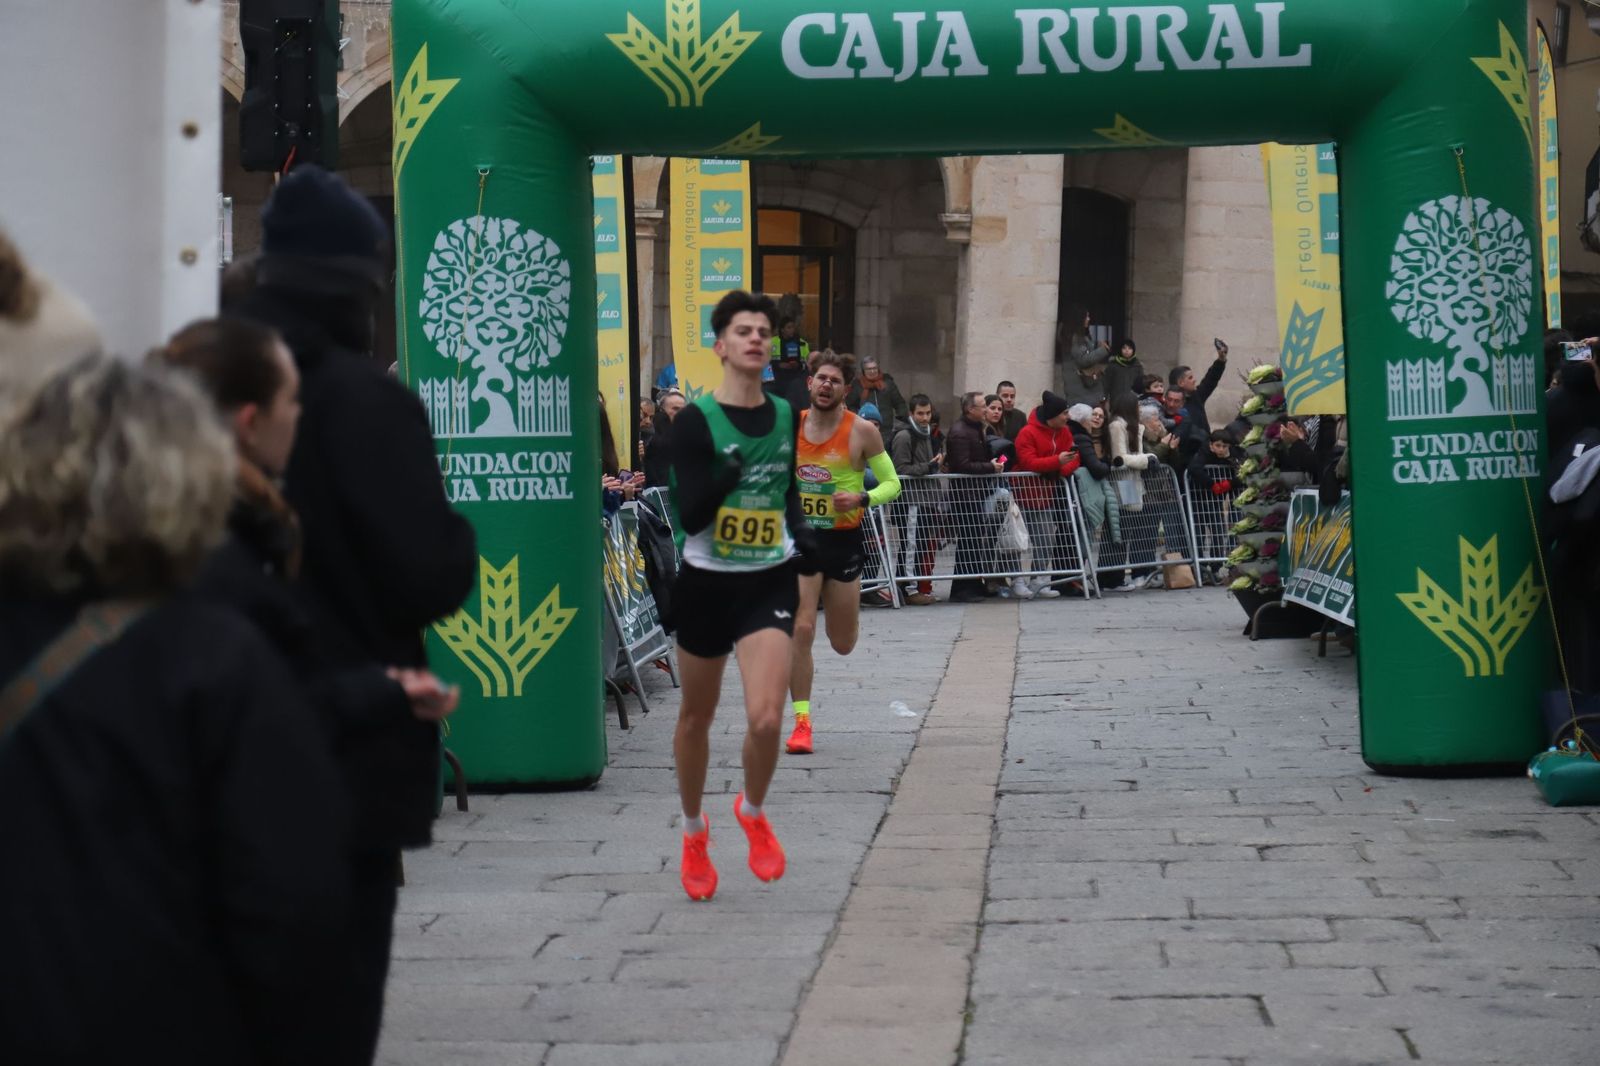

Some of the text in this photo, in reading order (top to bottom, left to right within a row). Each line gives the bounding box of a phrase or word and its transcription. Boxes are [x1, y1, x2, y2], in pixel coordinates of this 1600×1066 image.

[781, 2, 1312, 83] CAJA RURAL
[1391, 429, 1539, 458] FUNDACION
[436, 451, 573, 476] UNDACION
[1392, 454, 1541, 484] CAJA RURAL
[449, 476, 574, 503] JA RURAL
[801, 497, 828, 517] 56
[720, 514, 776, 545] 695
